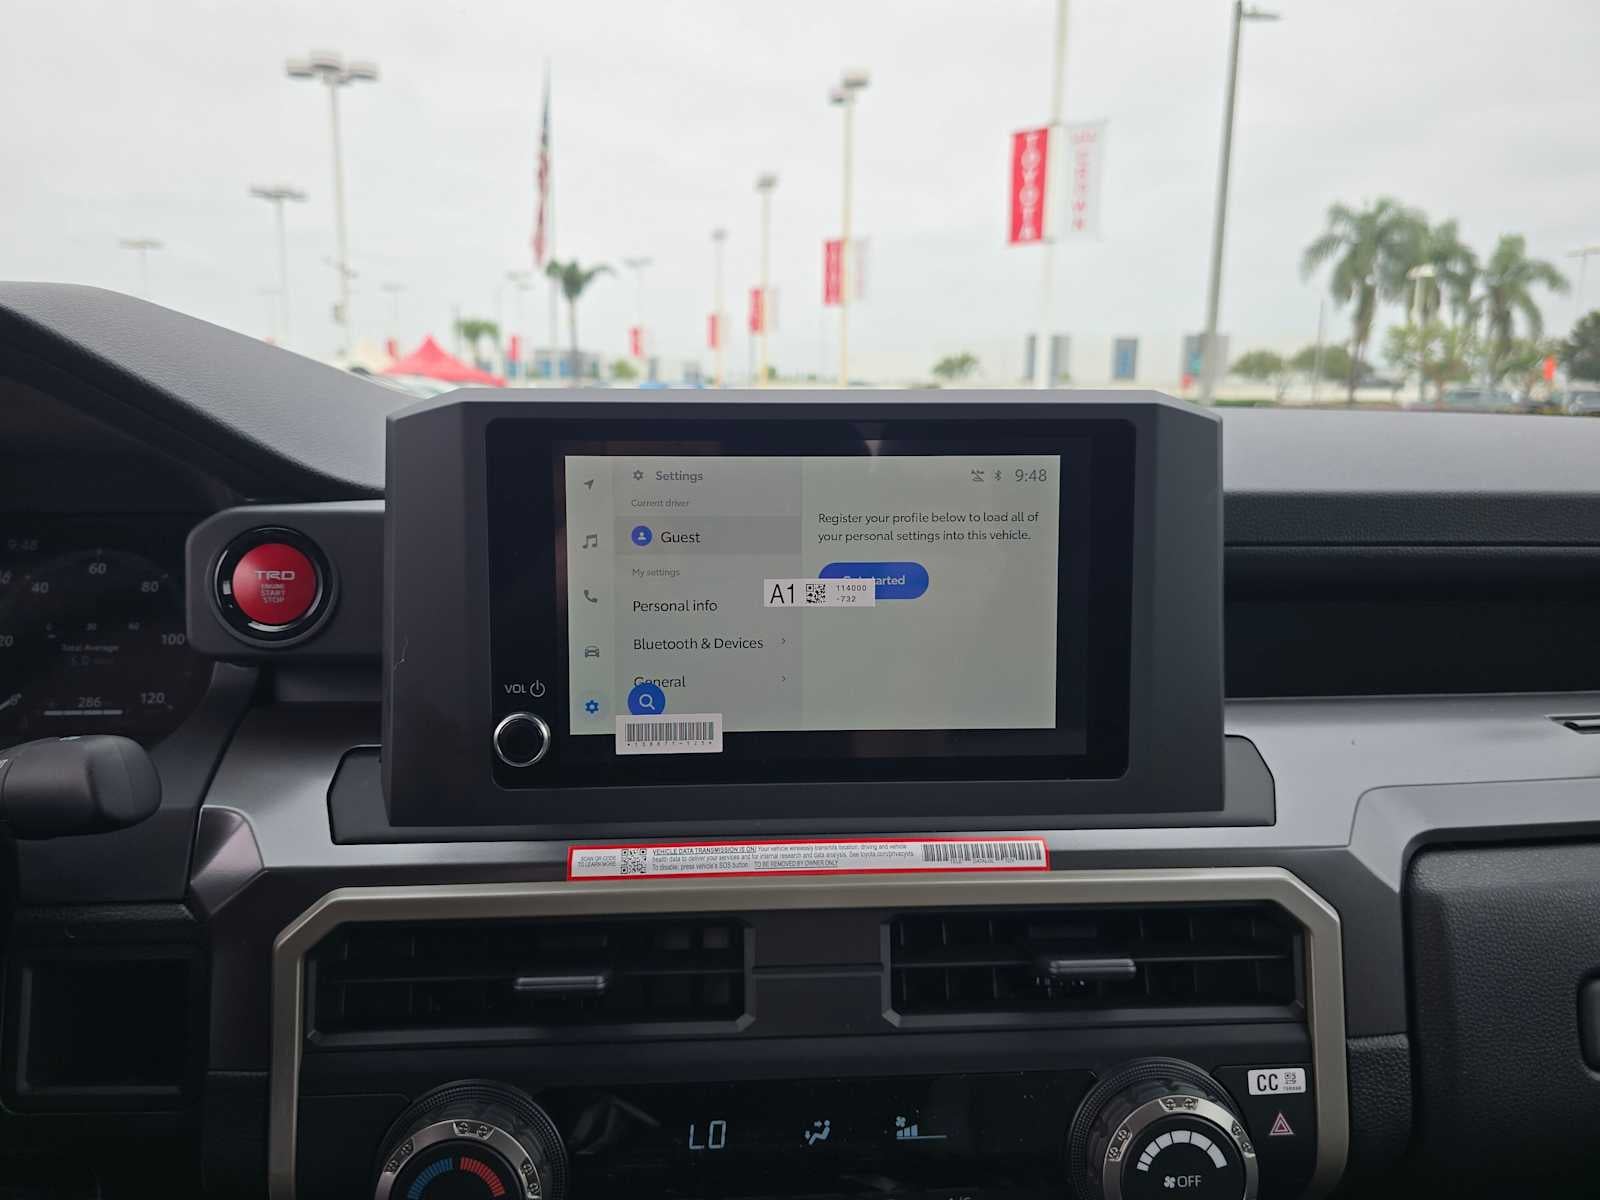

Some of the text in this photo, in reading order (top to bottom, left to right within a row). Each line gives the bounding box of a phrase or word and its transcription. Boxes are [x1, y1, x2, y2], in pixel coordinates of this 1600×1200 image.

[1019, 133, 1041, 240] TOYOTA
[656, 470, 703, 483] Settings
[1015, 468, 1047, 482] 9:48
[631, 498, 690, 508] Current driver
[819, 512, 1039, 525] Register your profile below to load all of
[660, 530, 701, 543] Guest
[818, 530, 1032, 544] your personal settings into this vehicle.
[88, 562, 107, 575] 60
[256, 570, 296, 580] TRD
[632, 568, 680, 578] My settings
[32, 581, 49, 594] 40
[140, 580, 159, 593] 80
[770, 583, 795, 604] A1
[836, 595, 857, 603] -732
[633, 599, 719, 612] Personal info
[161, 633, 185, 645] 100
[633, 637, 764, 650] Bluetooth & Devices
[504, 684, 527, 693] VOL
[78, 696, 102, 708] 286
[140, 692, 165, 704] 120
[652, 848, 679, 856] VEHICLE
[695, 847, 739, 855] TRANSMISSION
[1257, 1073, 1278, 1091] CC
[689, 1120, 727, 1149] LO
[1177, 1176, 1202, 1188] OFF
